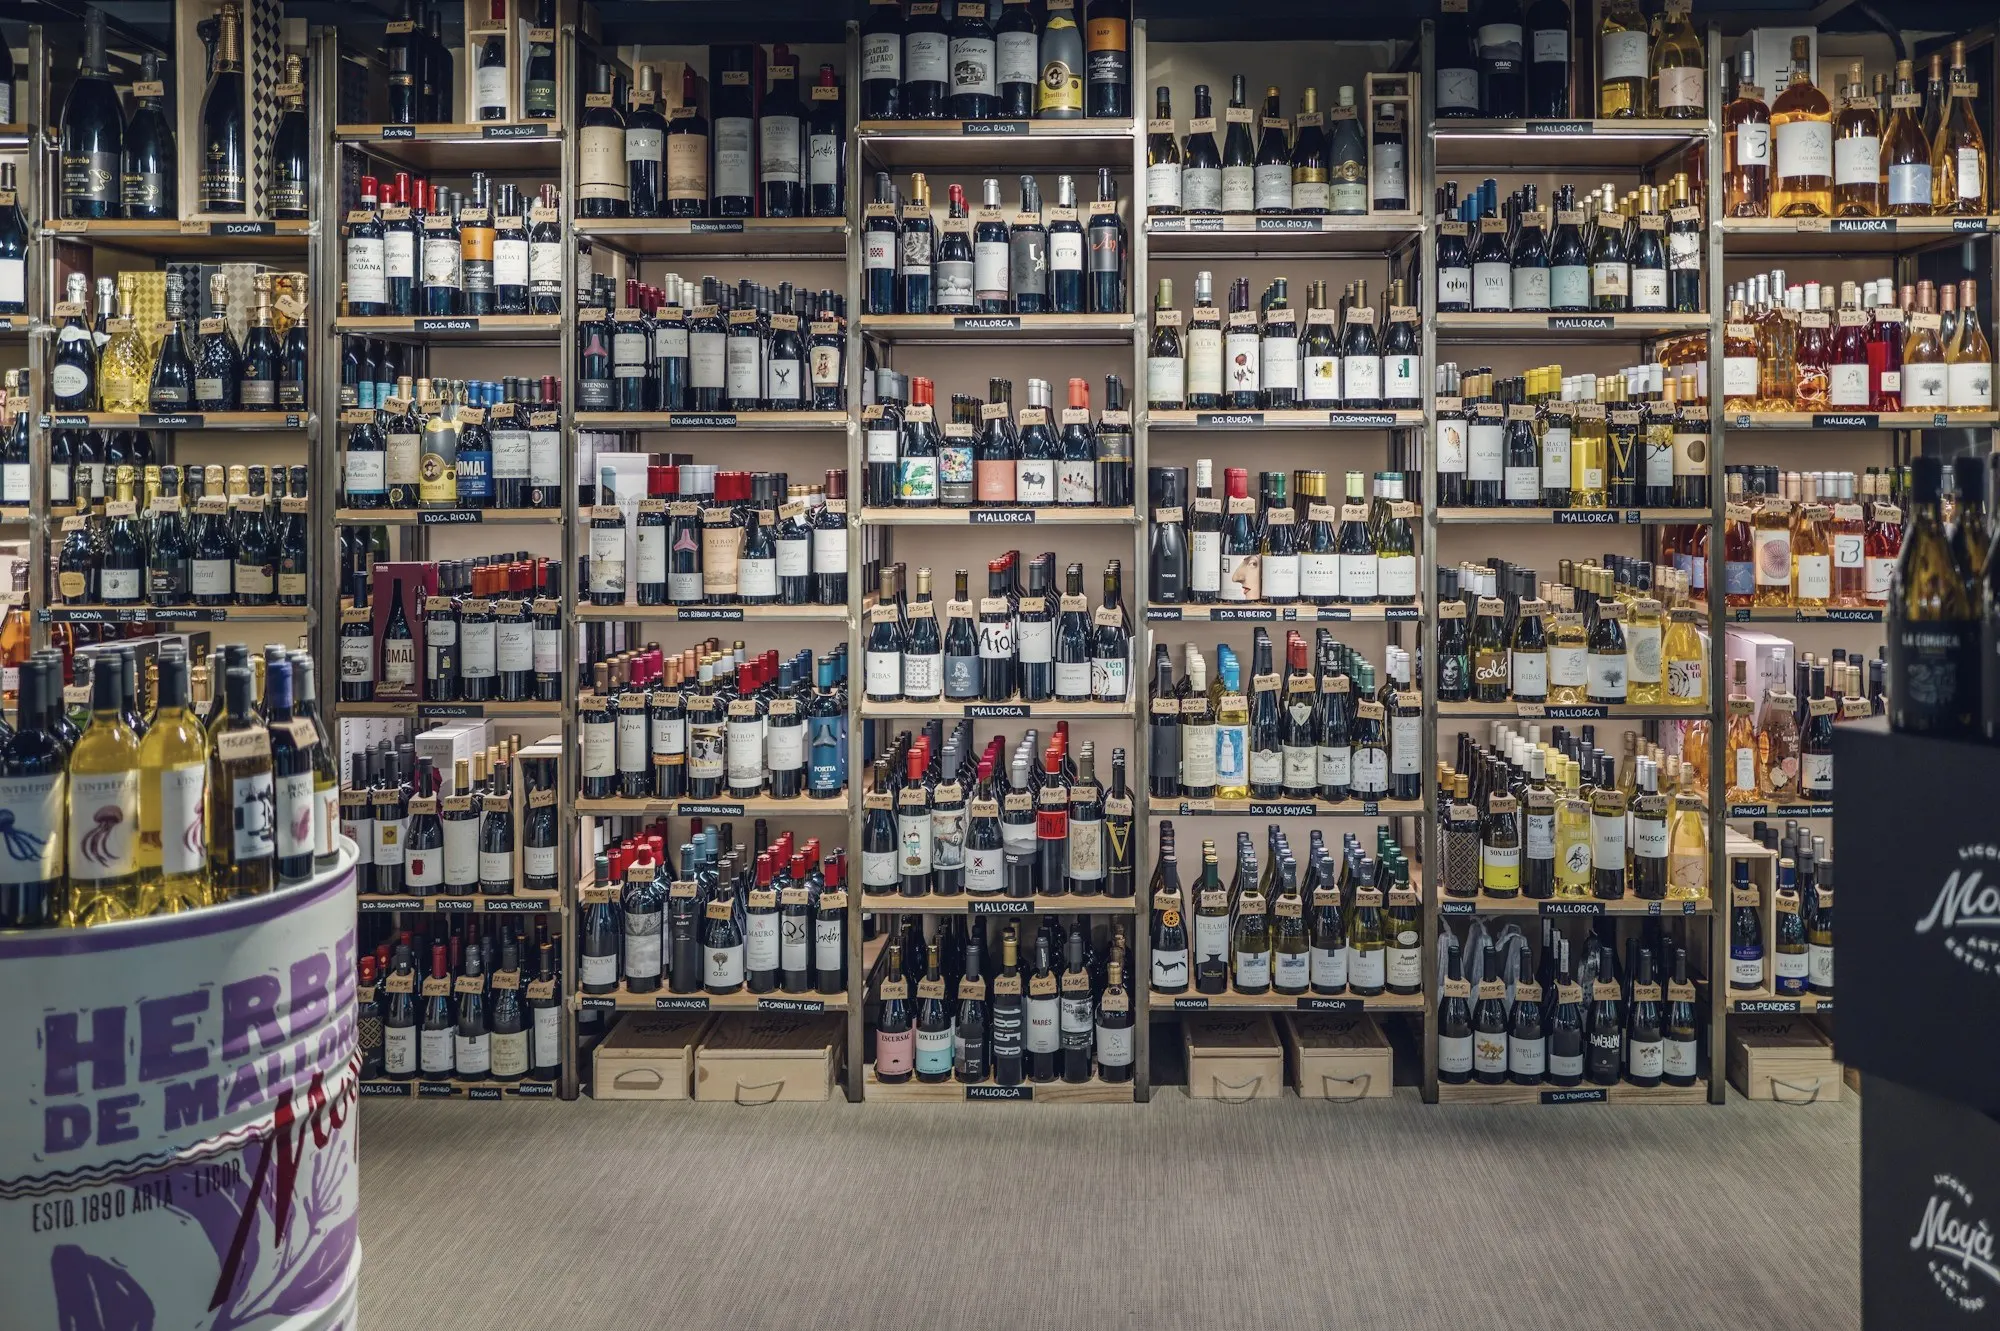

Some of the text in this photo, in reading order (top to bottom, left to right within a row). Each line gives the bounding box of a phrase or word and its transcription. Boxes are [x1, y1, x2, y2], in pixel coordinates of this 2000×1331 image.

[1840, 220, 1887, 230] MALLORCA
[1556, 320, 1606, 328] MALLORCA
[1824, 417, 1866, 425] MALLORCA
[978, 512, 1032, 522] MALLORCA
[1562, 513, 1614, 522] MALLORCA
[972, 707, 1023, 716] MALLORCA
[1550, 709, 1600, 718] MALLORCA
[1734, 807, 1765, 816] FRANCIA
[1958, 843, 2000, 861] LICO
[1915, 868, 2000, 933] Mo
[510, 902, 543, 910] PRIORAT
[975, 902, 1028, 912] MALLORCA
[1547, 904, 1599, 914] MALLORCA
[1966, 936, 2000, 954] ART
[1312, 1000, 1346, 1008] FRANCIA
[1757, 1003, 1795, 1012] PENEDES
[360, 1086, 402, 1094] VALENCIA
[971, 1088, 1019, 1097] MALLORCA
[45, 1093, 140, 1154] DE
[33, 1199, 79, 1233] ESTD.
[83, 1190, 125, 1225] 1890
[195, 1158, 241, 1198] LICOR
[1910, 1195, 1995, 1270] Moyà
